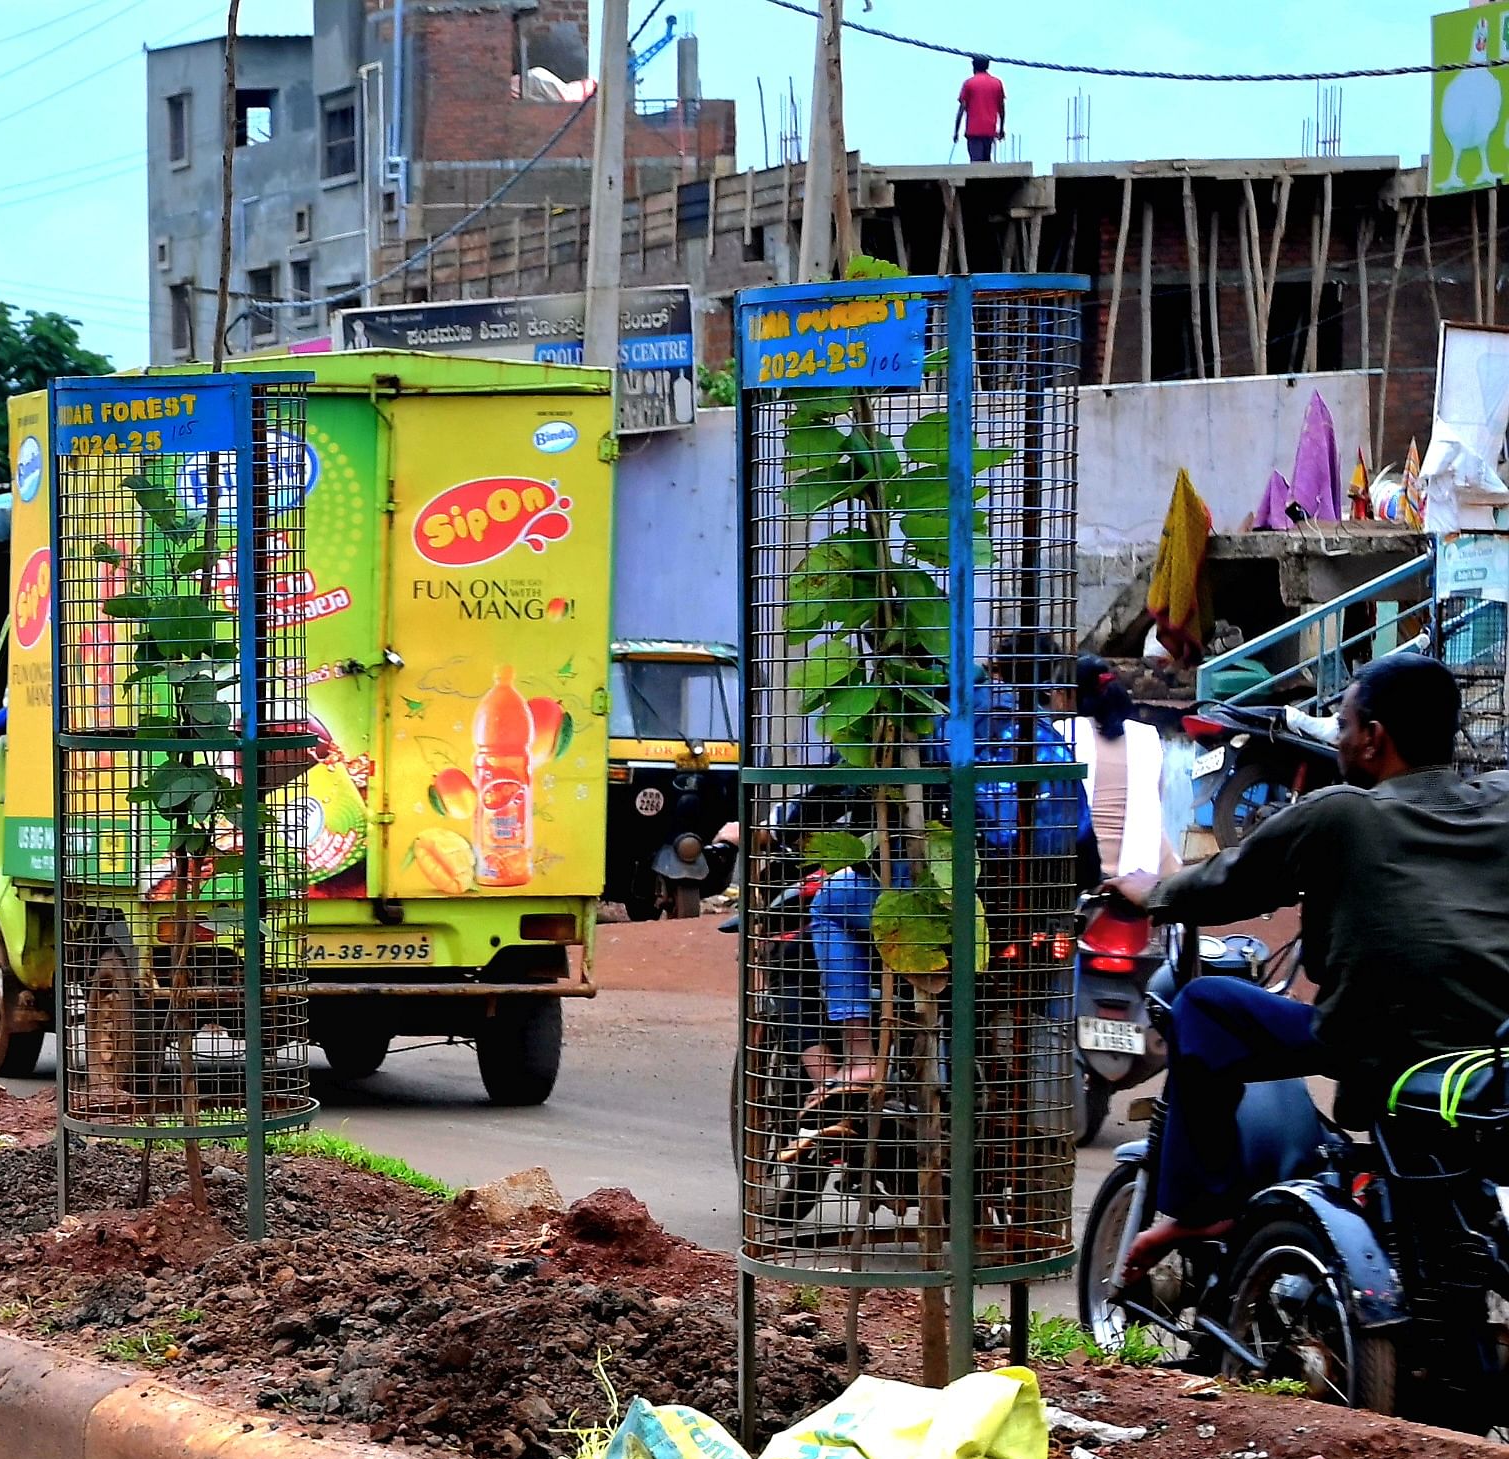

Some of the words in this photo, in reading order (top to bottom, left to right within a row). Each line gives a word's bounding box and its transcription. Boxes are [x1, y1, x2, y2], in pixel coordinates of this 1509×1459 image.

[631, 339, 688, 362] CENTRE
[758, 341, 868, 382] 2024-25
[870, 353, 900, 377] 106
[101, 394, 197, 423] FOREST
[173, 420, 199, 440] 105
[535, 427, 573, 446] Bindu
[71, 431, 162, 456] 2024-25
[422, 486, 546, 548] SipOn
[17, 561, 50, 629] SipO
[413, 580, 461, 600] FUN
[470, 579, 509, 599] ON
[510, 588, 542, 597] WITH
[644, 746, 673, 757] FOR
[706, 746, 732, 757] IRE
[302, 943, 430, 961] KA-38-7995
